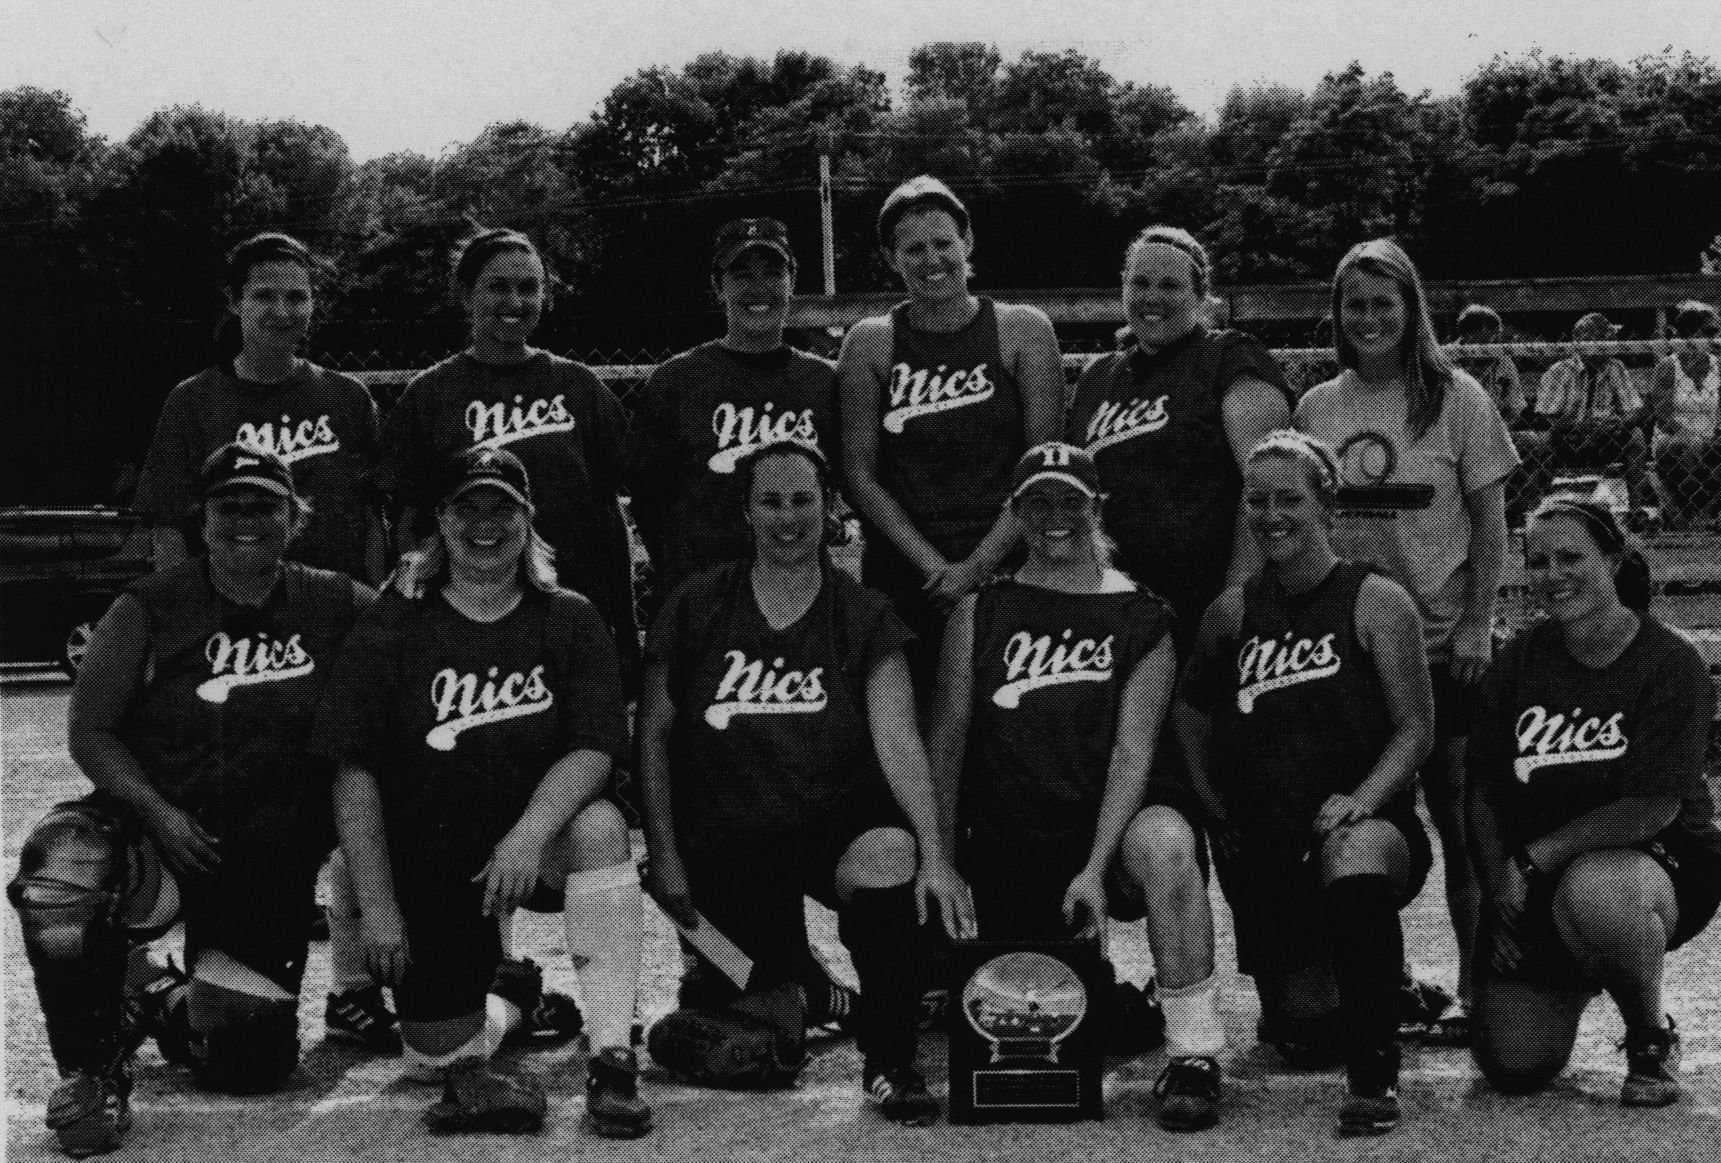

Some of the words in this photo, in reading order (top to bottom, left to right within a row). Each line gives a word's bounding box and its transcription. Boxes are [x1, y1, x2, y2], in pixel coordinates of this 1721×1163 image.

[890, 362, 992, 406] Nics
[465, 394, 571, 441] Nics
[712, 402, 817, 448] Nics
[1087, 395, 1168, 441] Nics
[205, 631, 312, 675] Nics
[715, 649, 824, 701] Nics
[1003, 628, 1113, 681] Nics
[1238, 631, 1339, 685] Nics
[431, 664, 551, 721] Nics
[1515, 705, 1626, 754] Nics
